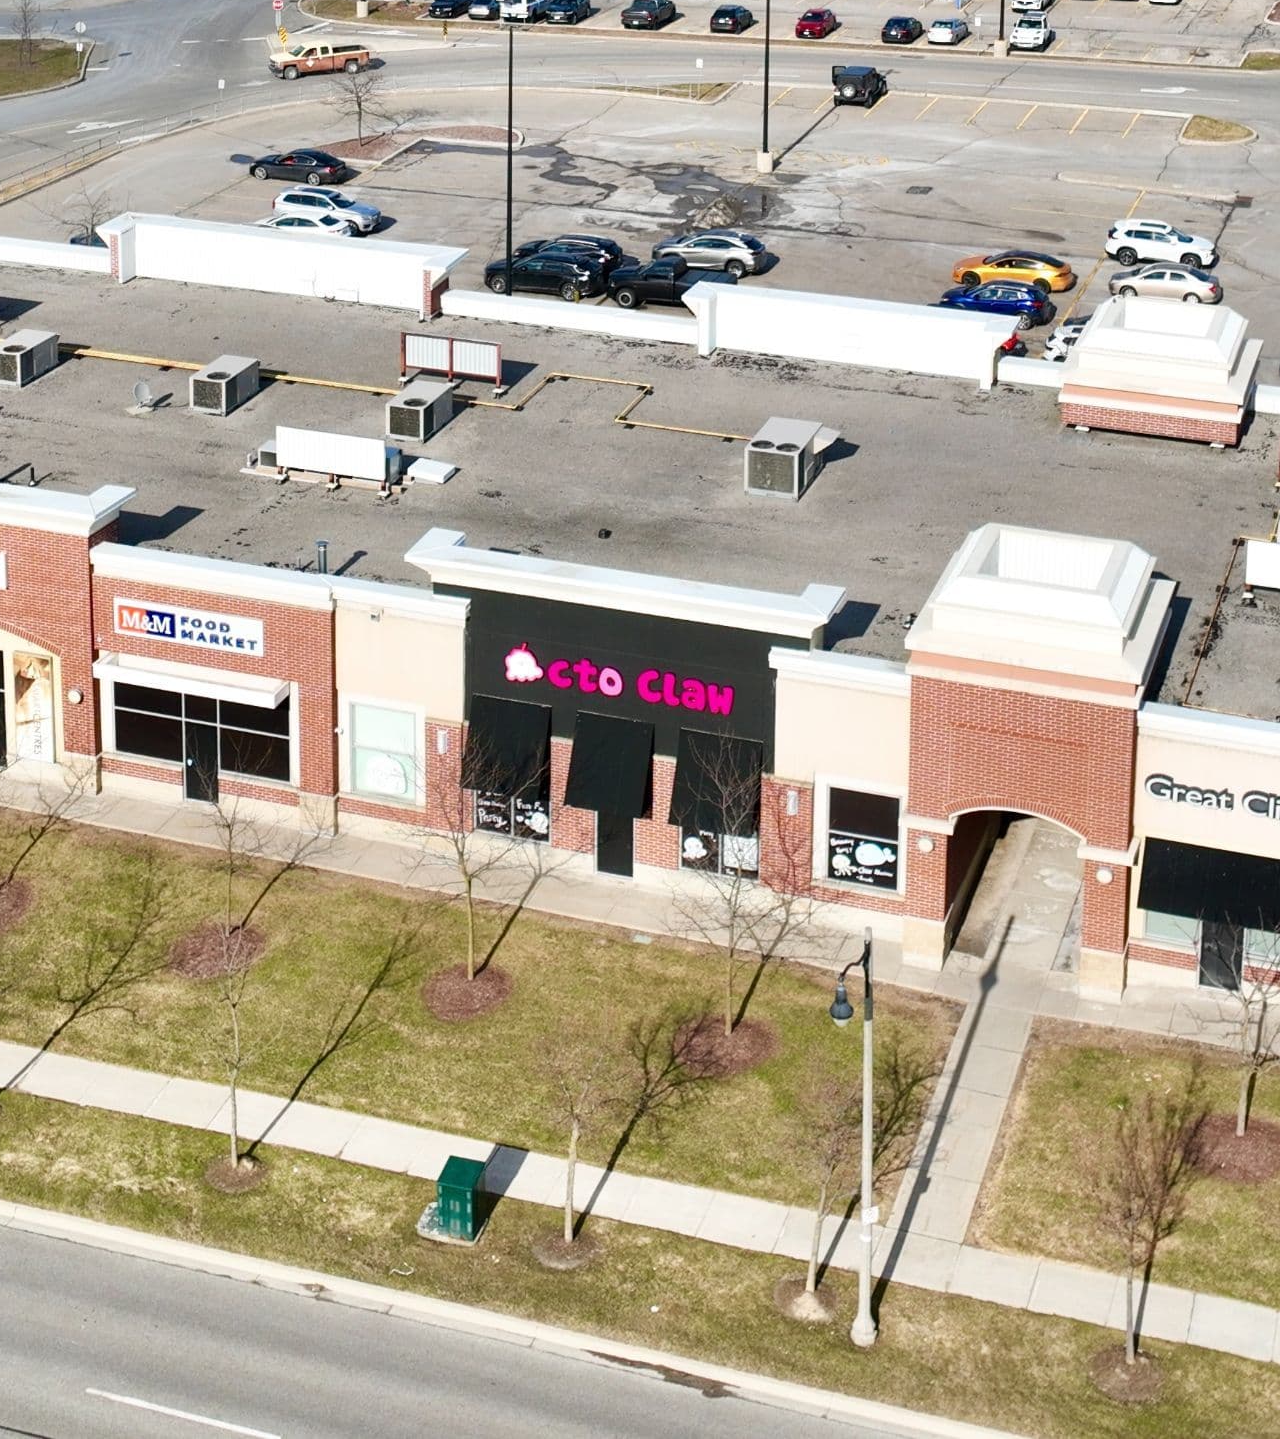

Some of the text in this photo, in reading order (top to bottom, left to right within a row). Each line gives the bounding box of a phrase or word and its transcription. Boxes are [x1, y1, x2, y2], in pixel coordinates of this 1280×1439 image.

[121, 609, 172, 635] M&M
[180, 616, 231, 633] FOOD
[180, 628, 258, 651] MARKET
[1144, 773, 1234, 811] Great
